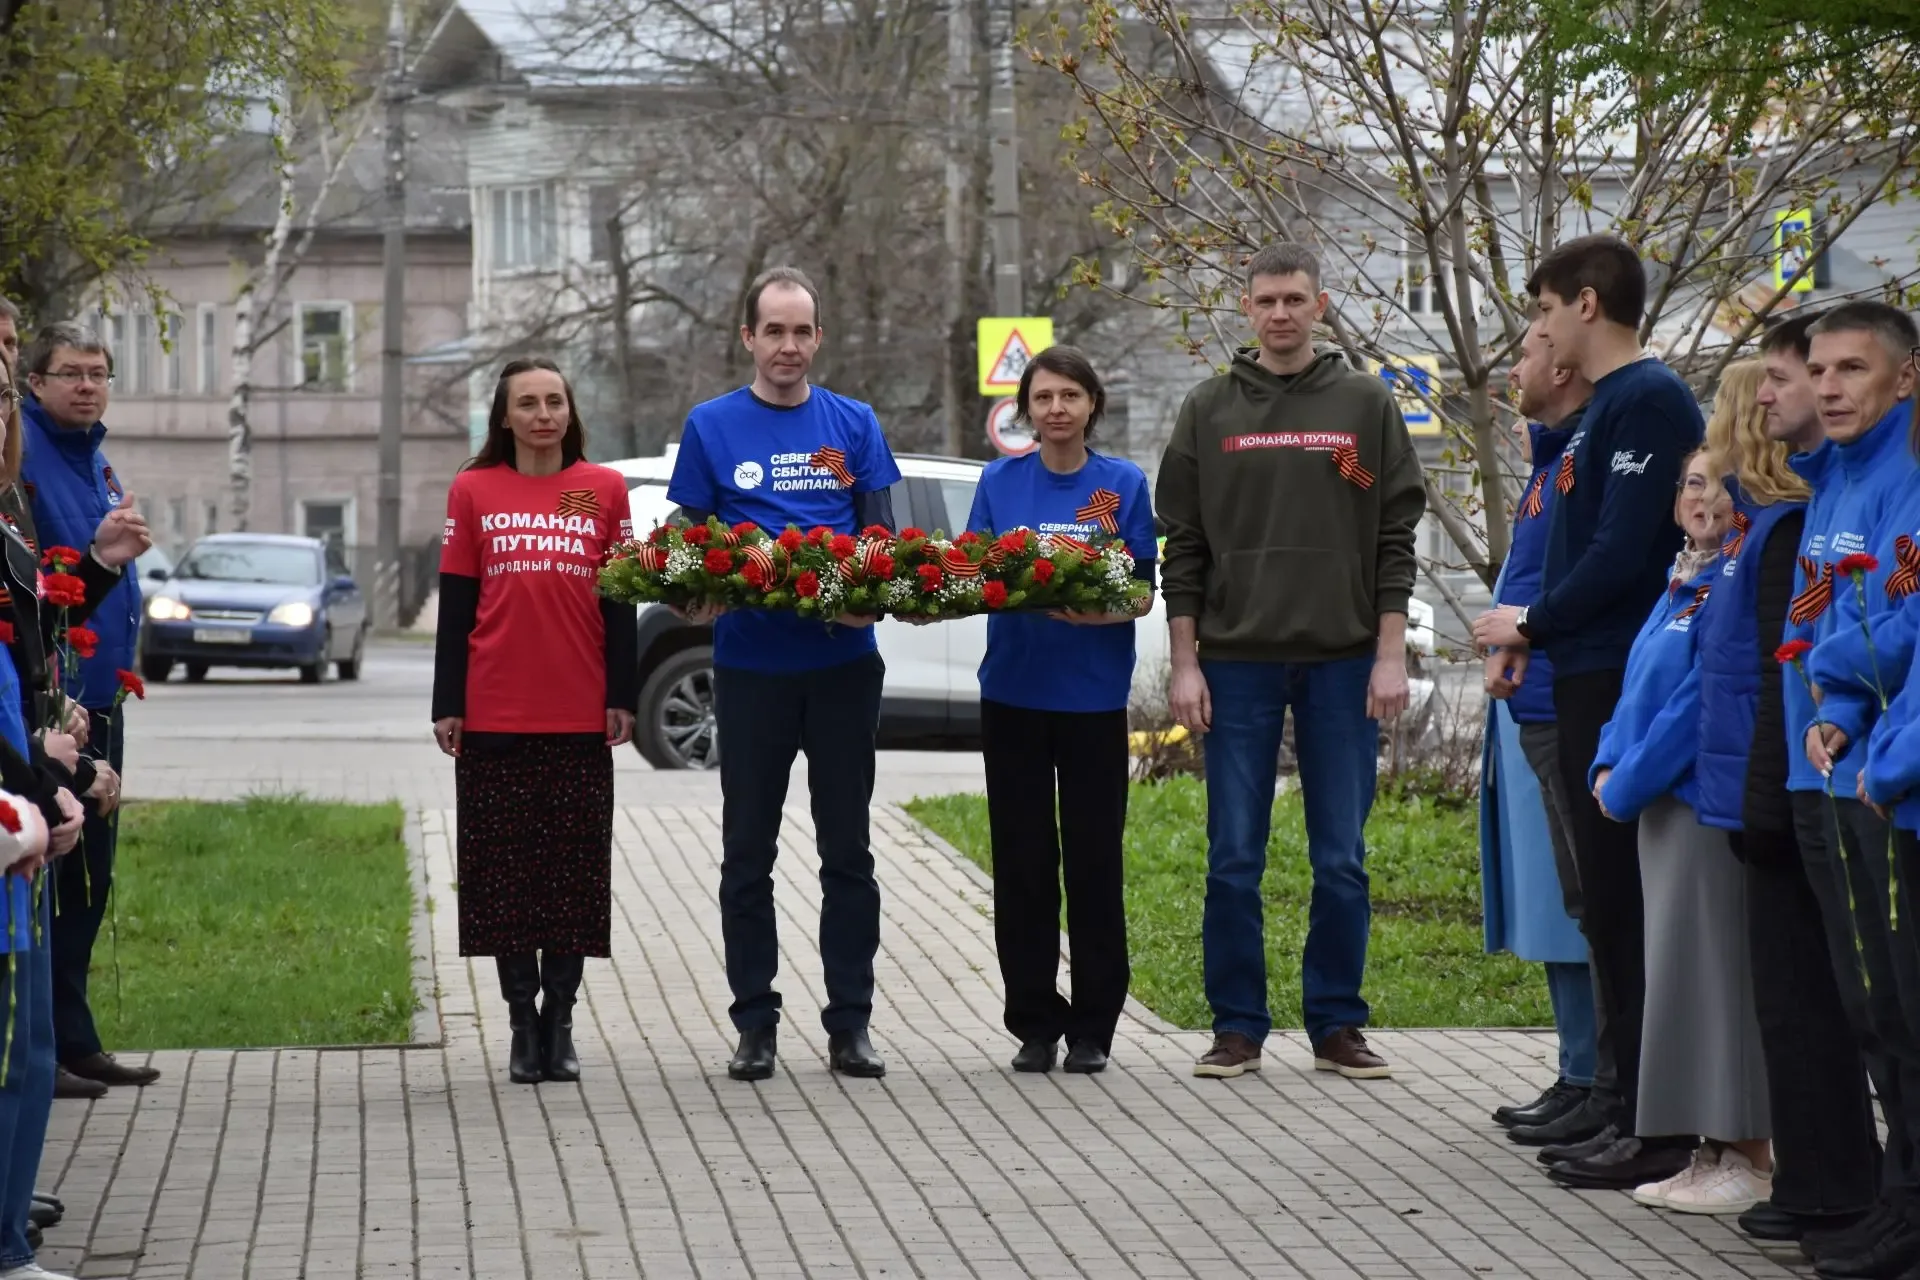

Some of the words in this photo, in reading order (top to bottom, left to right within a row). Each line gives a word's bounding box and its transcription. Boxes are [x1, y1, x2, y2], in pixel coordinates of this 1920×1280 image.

[1239, 434, 1300, 447] КОМАНДА
[1303, 434, 1353, 446] ПУТИНА
[770, 453, 817, 465] СЕВЕР
[771, 465, 833, 478] СБЫТОВ
[481, 512, 596, 536] КОМАНДА
[492, 534, 586, 556] ПУТИНА
[487, 559, 551, 577] НАРОДНЫЙ
[556, 562, 593, 579] ФРОНТ
